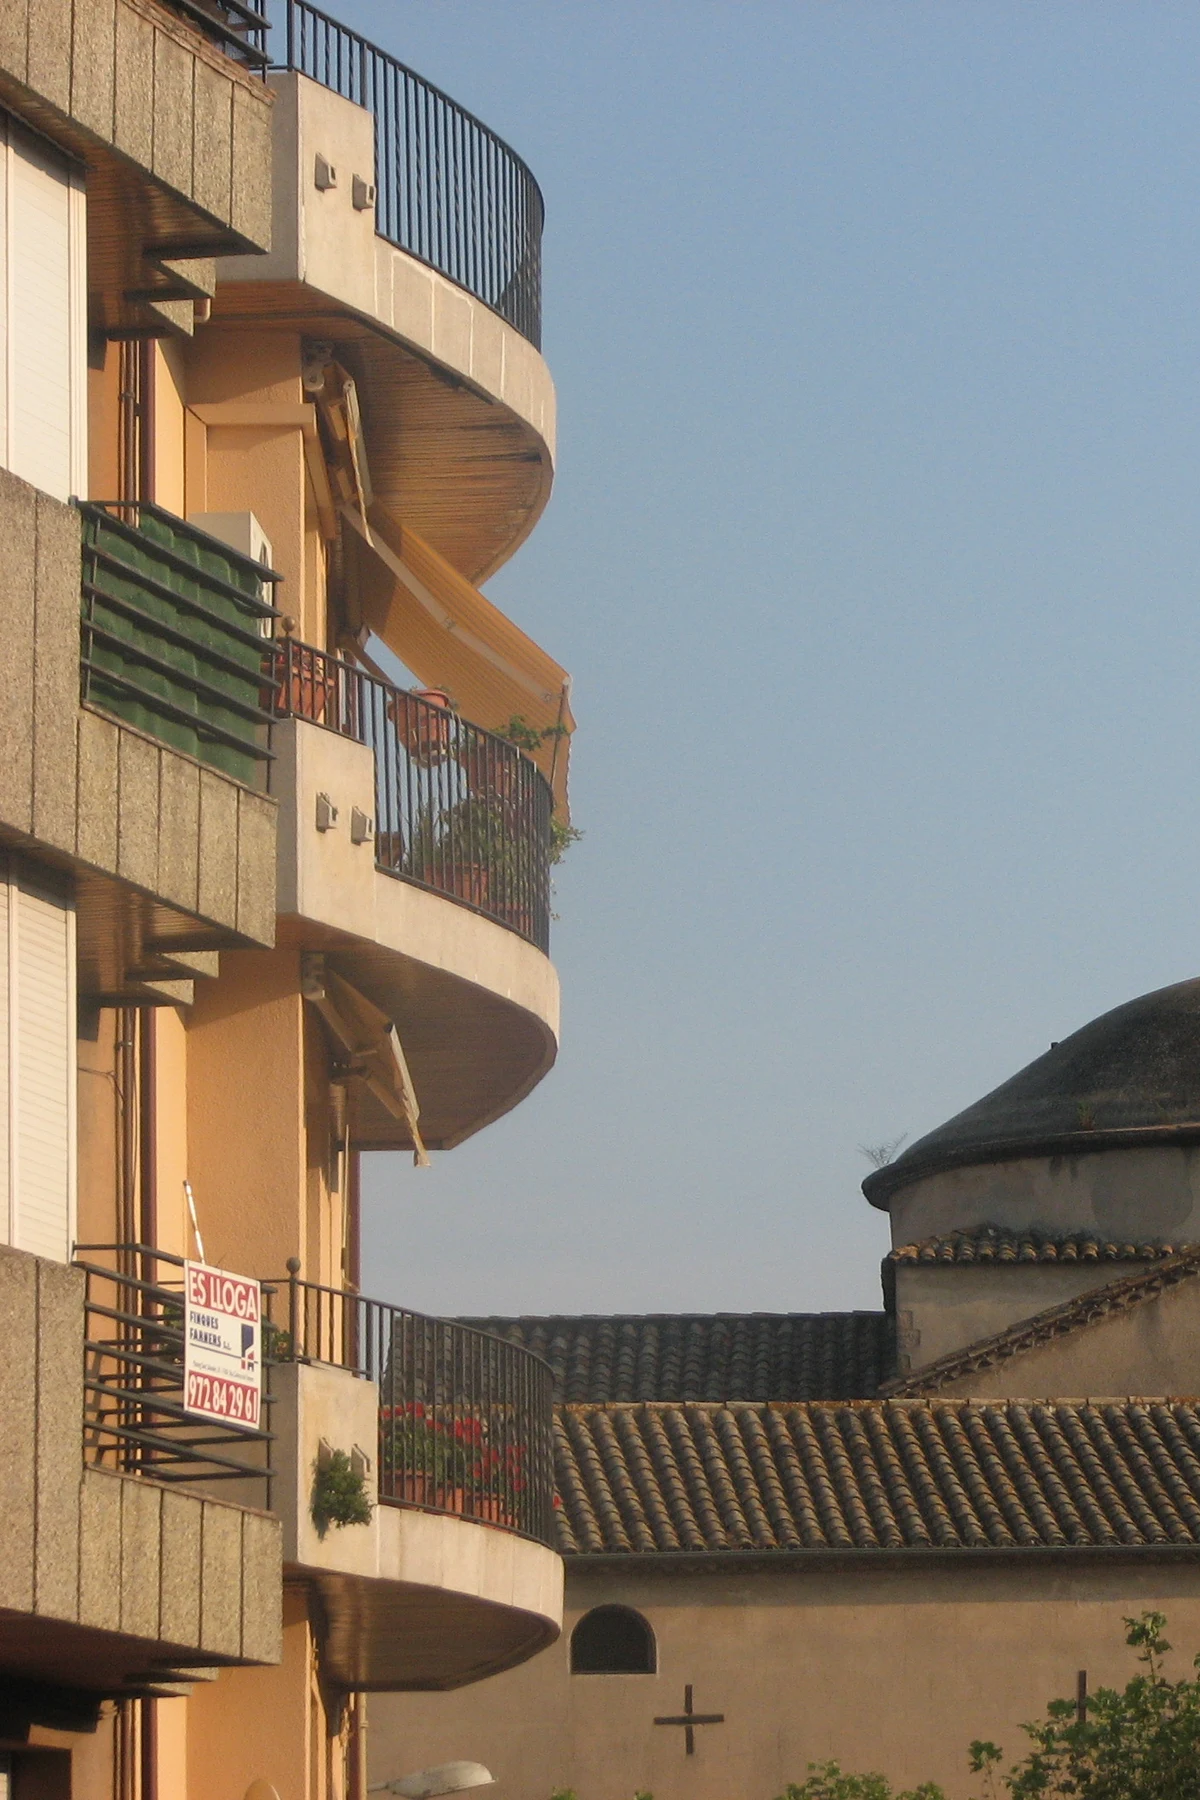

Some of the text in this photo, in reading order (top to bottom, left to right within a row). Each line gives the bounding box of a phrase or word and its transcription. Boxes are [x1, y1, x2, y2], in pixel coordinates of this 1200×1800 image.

[190, 1270, 257, 1321] ES LLOGA
[190, 1310, 219, 1330] FINQUES
[189, 1327, 221, 1348] FARNERS
[189, 1374, 257, 1421] 972 84 29 61
